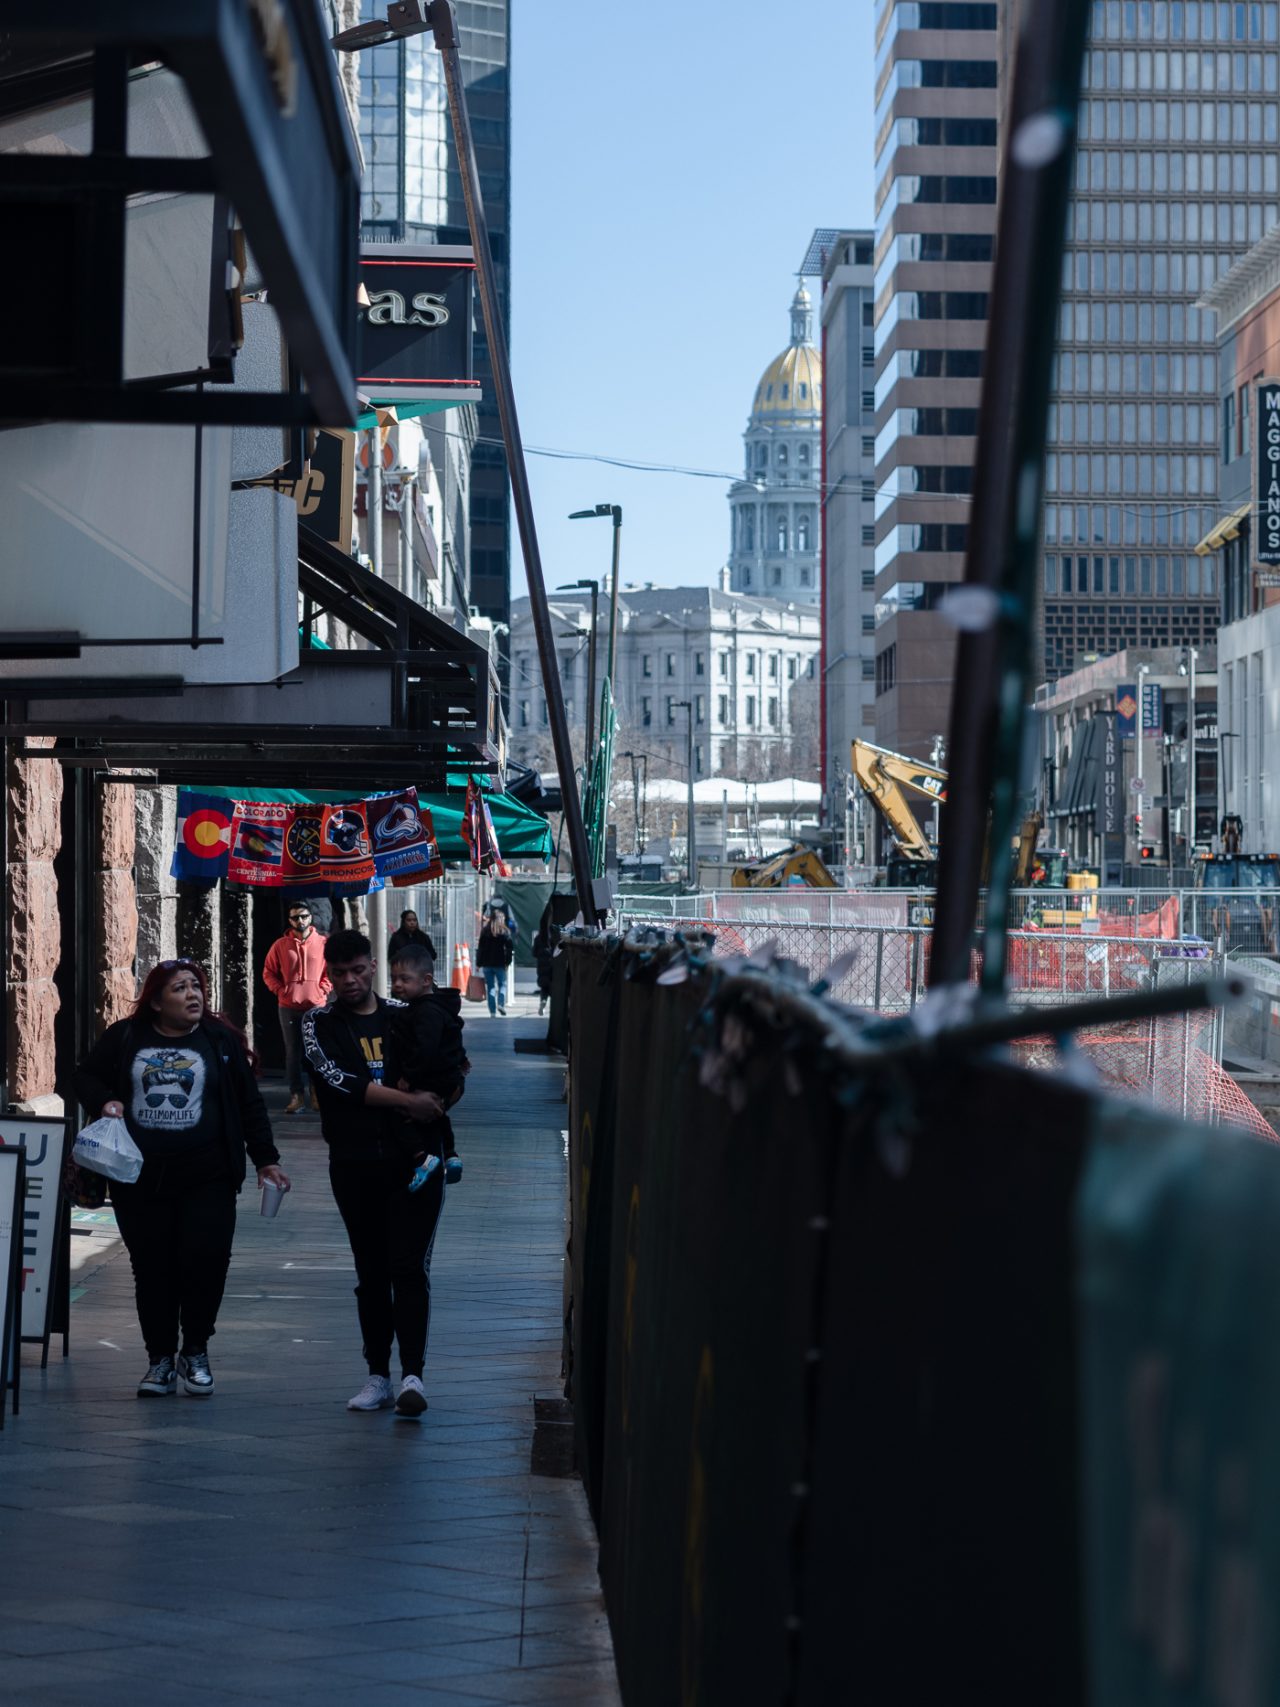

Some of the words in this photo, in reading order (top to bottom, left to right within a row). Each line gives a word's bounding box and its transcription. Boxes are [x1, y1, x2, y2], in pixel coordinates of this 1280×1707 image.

[1105, 716, 1115, 765] YARD
[923, 776, 942, 795] CAT
[1105, 771, 1115, 832] HOUSE
[236, 806, 284, 818] COLORADO
[322, 864, 374, 876] BRONCOS
[138, 1109, 195, 1120] #T21MOMLIFE
